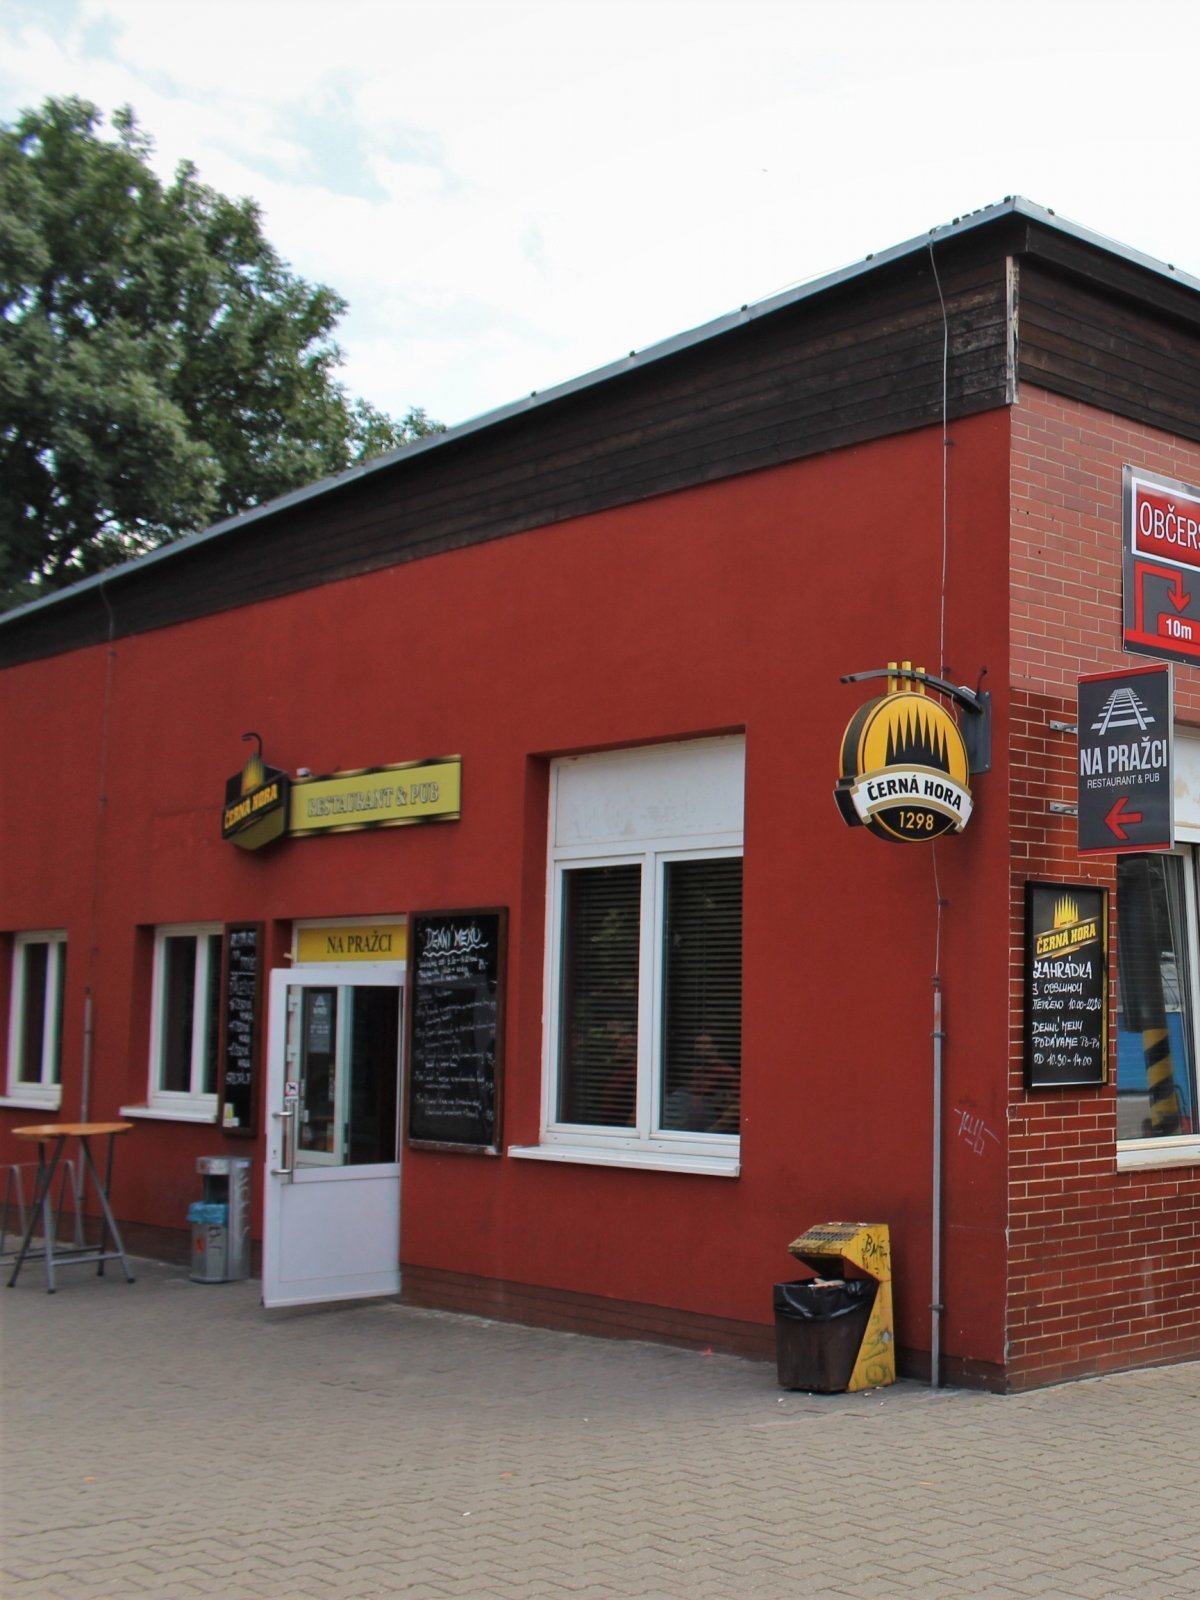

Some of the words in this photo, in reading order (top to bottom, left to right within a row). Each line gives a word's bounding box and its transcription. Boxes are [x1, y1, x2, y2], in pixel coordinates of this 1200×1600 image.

[1165, 618, 1192, 640] 10m
[1080, 747, 1104, 777] NA
[1107, 736, 1167, 774] PRAŽCI
[866, 774, 920, 802] ČERNÁ
[924, 779, 962, 812] HORA
[1086, 774, 1137, 790] RESTAURANT
[1138, 774, 1143, 784] &
[1144, 772, 1160, 783] PUB
[307, 787, 394, 817] RESTAURANT
[396, 783, 408, 806] &
[410, 781, 440, 805] PUB
[224, 797, 251, 830] ČERNÁ
[899, 811, 934, 830] 1298
[327, 935, 344, 954] NA
[347, 929, 393, 953] PRAŽCI
[1036, 929, 1069, 955] ČERNÁ
[1071, 922, 1097, 944] HORA
[1032, 955, 1093, 980] ZAHRÁDKA
[1032, 1033, 1079, 1050] PODÁVÁME
